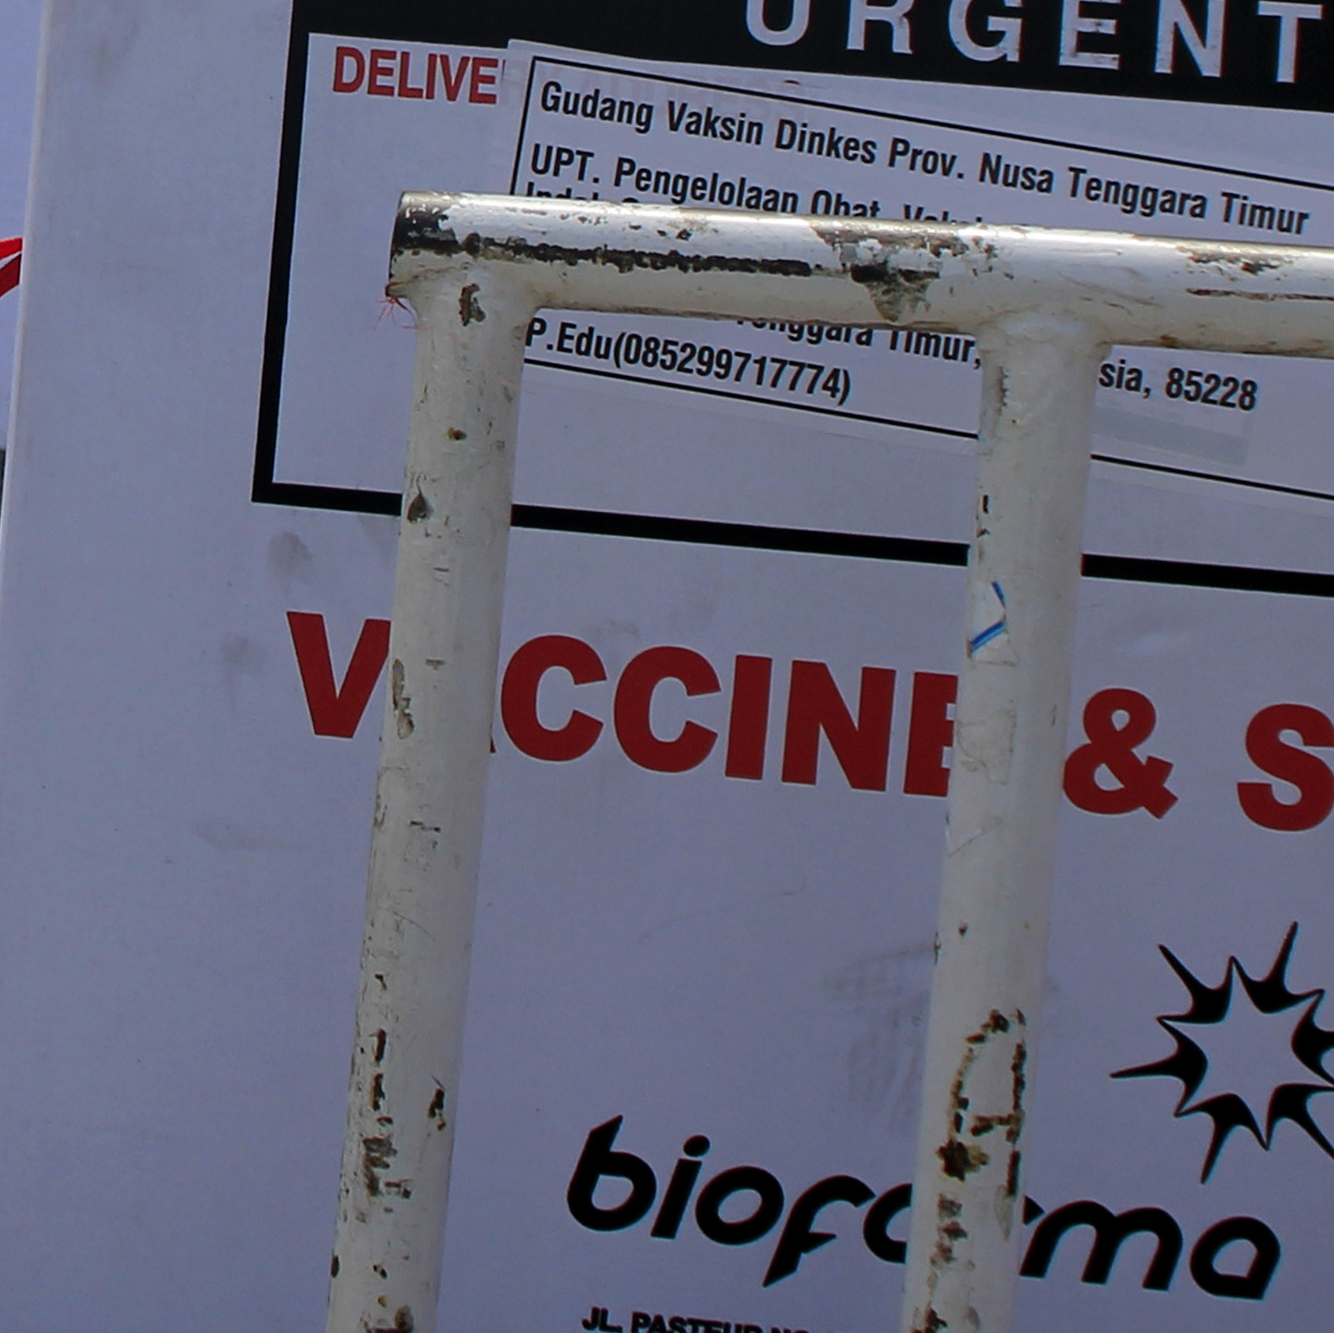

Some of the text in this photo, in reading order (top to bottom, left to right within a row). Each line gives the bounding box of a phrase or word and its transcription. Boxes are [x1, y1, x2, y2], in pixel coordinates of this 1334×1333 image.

[333, 46, 505, 104] DELIVE
[531, 143, 601, 184] UPT.
[614, 157, 799, 213] Pengelolaan
[541, 80, 1309, 235] Gudang Vaksin Dinkes Prov. Nusa Tenggara Timur
[525, 317, 851, 405] P.Edu(085299717774)
[1165, 367, 1258, 411] 85228
[1062, 688, 1178, 819] &
